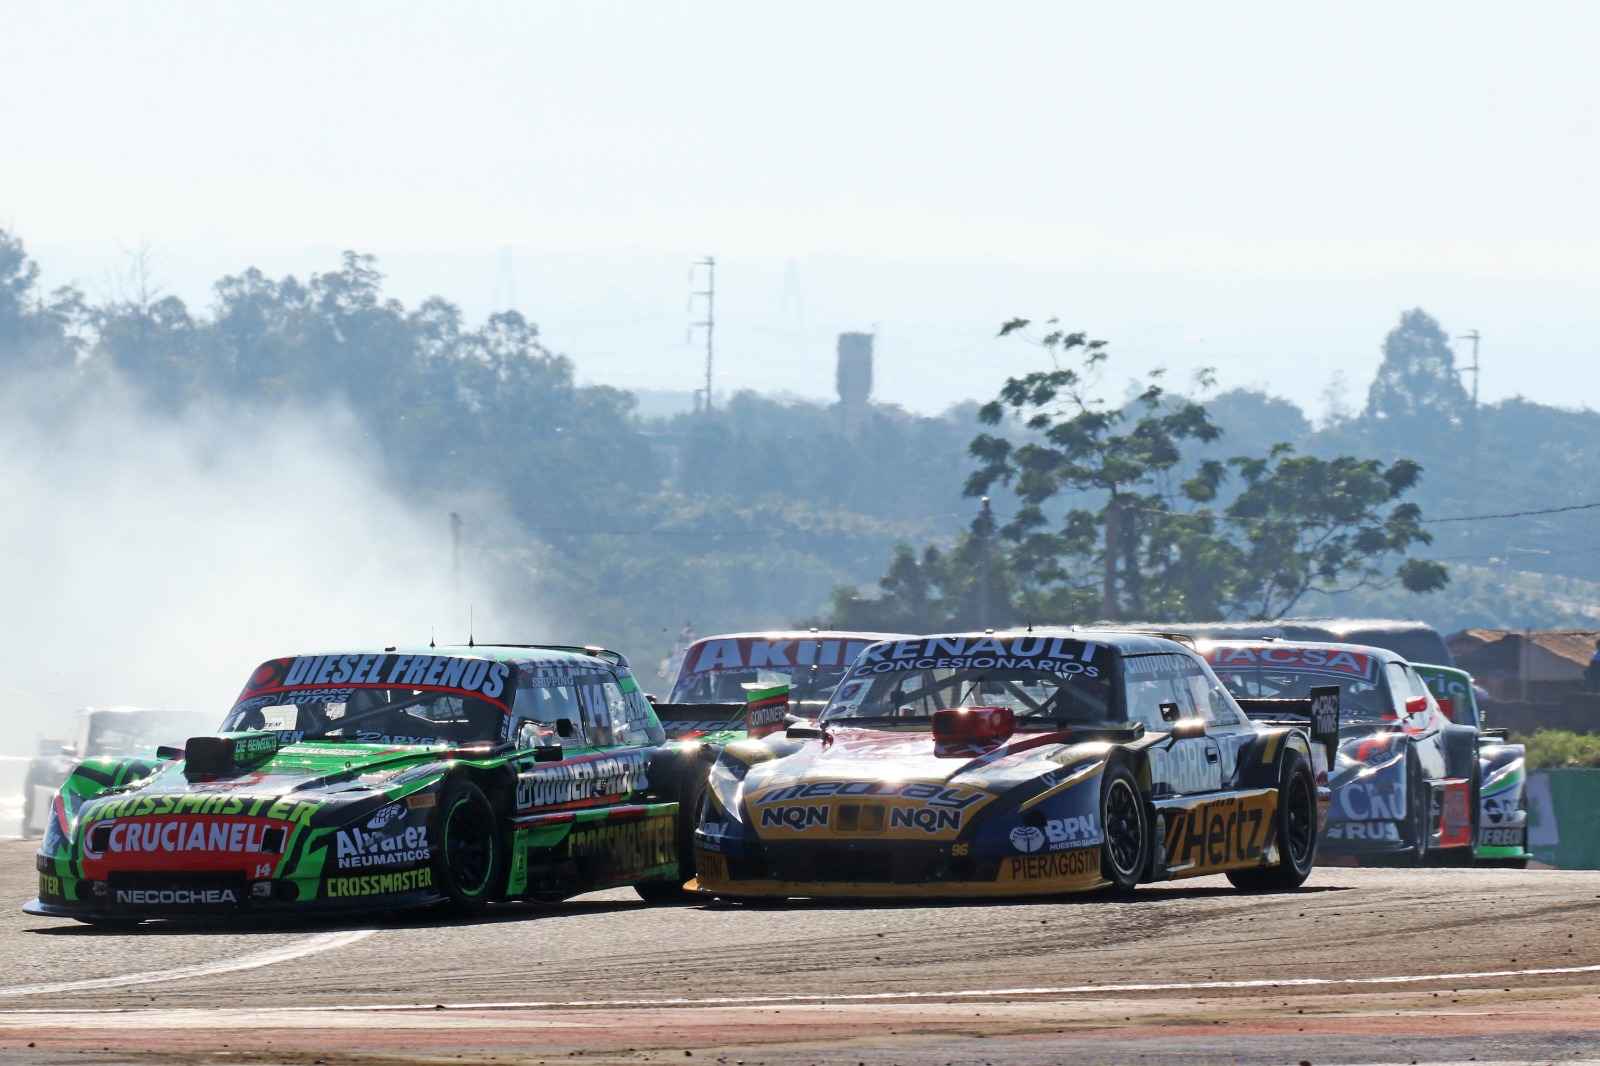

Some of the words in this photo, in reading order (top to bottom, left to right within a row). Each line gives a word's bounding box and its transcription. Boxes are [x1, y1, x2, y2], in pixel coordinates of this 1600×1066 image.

[857, 637, 1109, 664] RENAULT
[283, 655, 388, 687] DIESEL
[386, 654, 509, 699] FRENOS
[854, 657, 1100, 678] CONCESIONARIOS
[289, 687, 356, 698] BALCARCE
[532, 676, 574, 688] SHIPPING
[283, 694, 349, 705] AUTOS
[582, 684, 611, 728] 14
[751, 704, 787, 727] CONTAINERS
[235, 740, 247, 753] DE
[79, 793, 323, 827] CROSSMASTER
[760, 804, 829, 831] NQN
[888, 805, 963, 833] NQN
[1045, 813, 1098, 843] BPN
[1181, 800, 1264, 866] Hertz
[336, 826, 428, 859] Alvarez
[951, 843, 969, 856] 96
[1049, 841, 1082, 851] NUESTRO
[254, 863, 271, 878] 14
[338, 848, 431, 869] NEUMATICOS
[1011, 847, 1099, 881] PIERAGOSTINI
[326, 866, 432, 898] CROSSMASTER
[116, 888, 237, 904] NECOCHEA
